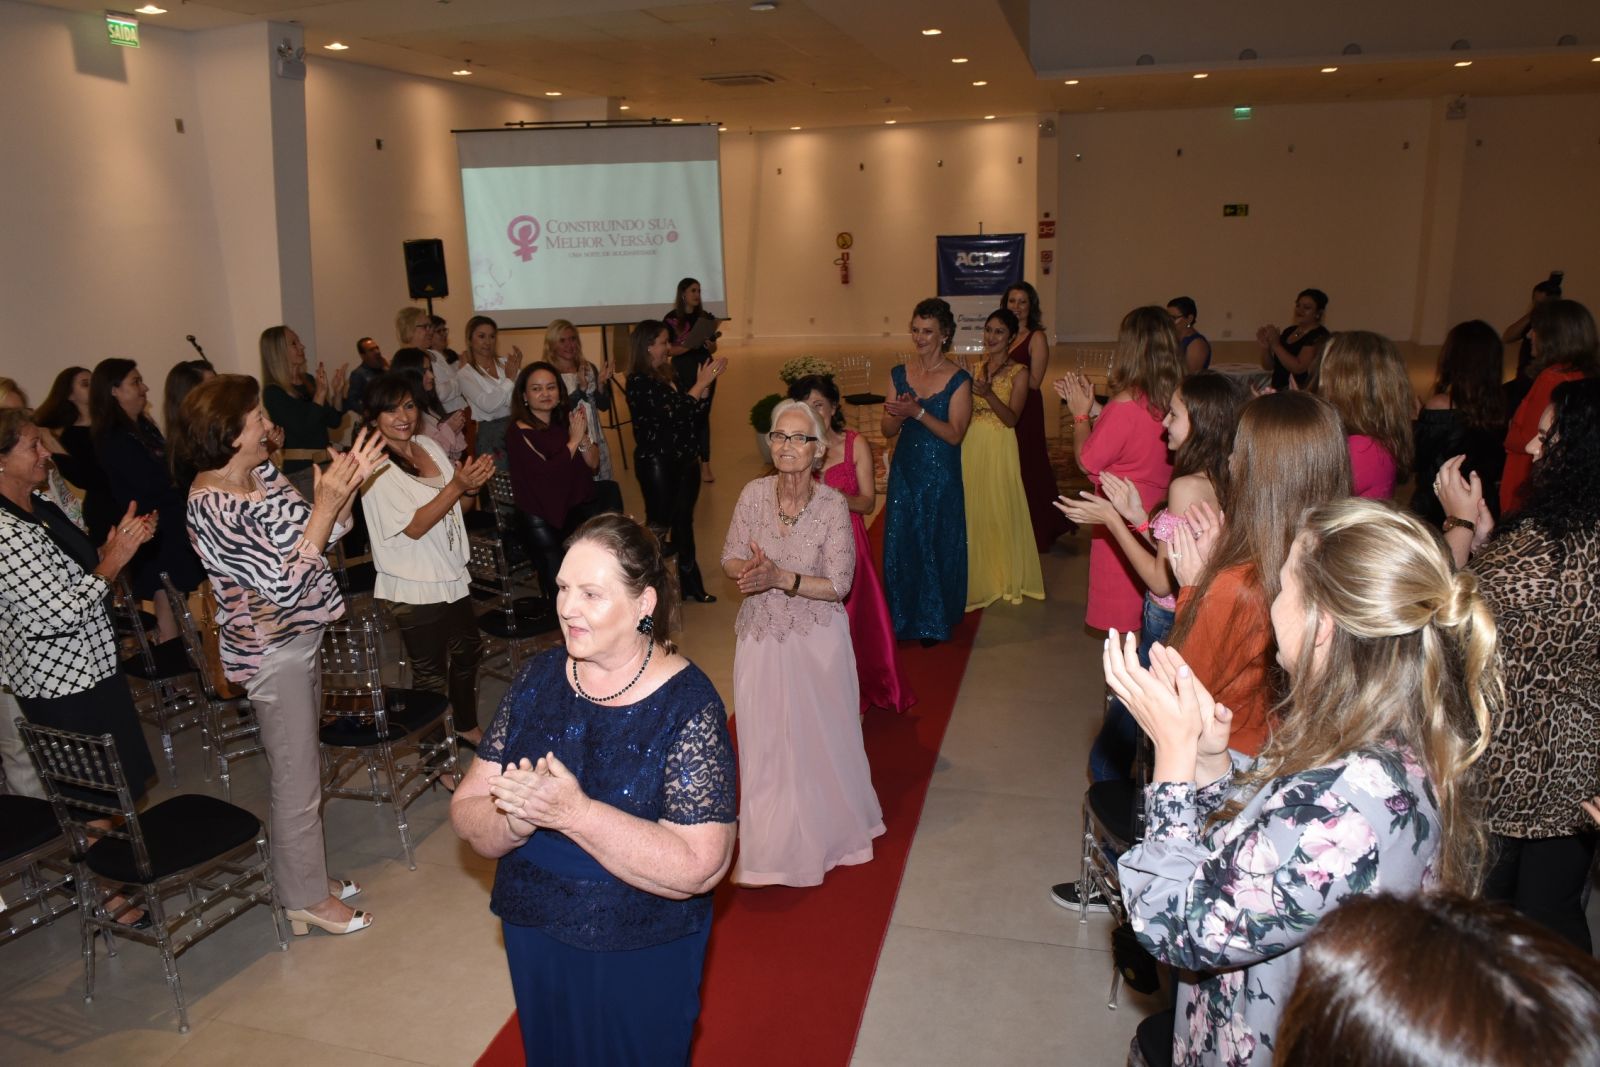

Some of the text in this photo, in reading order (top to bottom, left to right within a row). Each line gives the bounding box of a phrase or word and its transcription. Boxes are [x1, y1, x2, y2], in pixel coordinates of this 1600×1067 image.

[108, 23, 137, 42] SAÍDA
[546, 218, 676, 233] CONSTRUINDO SUA
[546, 232, 664, 249] MELHOR VERSÃO
